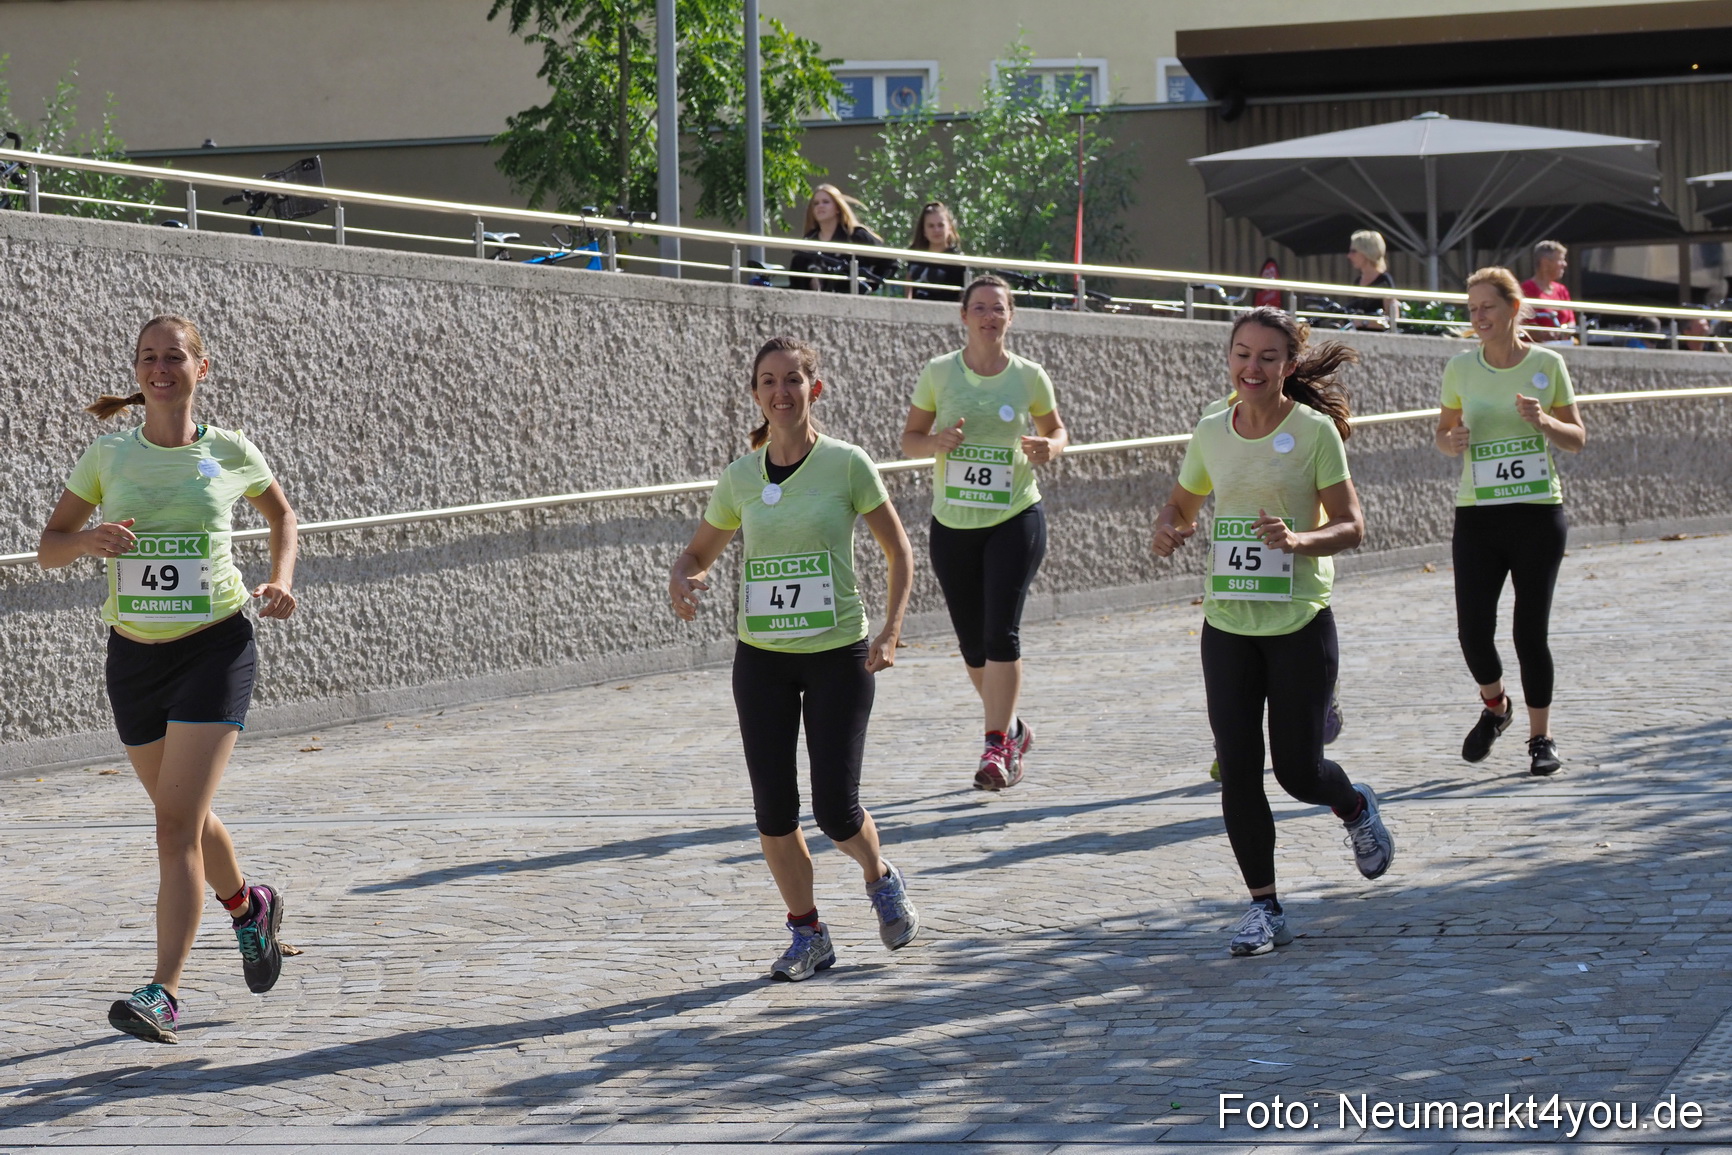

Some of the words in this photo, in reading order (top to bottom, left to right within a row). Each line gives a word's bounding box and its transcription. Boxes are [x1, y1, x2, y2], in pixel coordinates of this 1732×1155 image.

[950, 446, 1009, 463] BOCK
[1476, 437, 1540, 459] BOCK
[964, 466, 992, 486] 48
[1496, 460, 1525, 480] 46
[959, 490, 994, 501] PETRA
[1494, 485, 1531, 497] SILVIA
[1217, 520, 1268, 539] BOC
[750, 555, 823, 579] BOCK
[1228, 546, 1262, 571] 45
[141, 565, 180, 591] 49
[1228, 578, 1259, 590] SUSI
[131, 600, 193, 611] CARMEN
[769, 583, 801, 609] 47
[768, 616, 809, 629] JULIA
